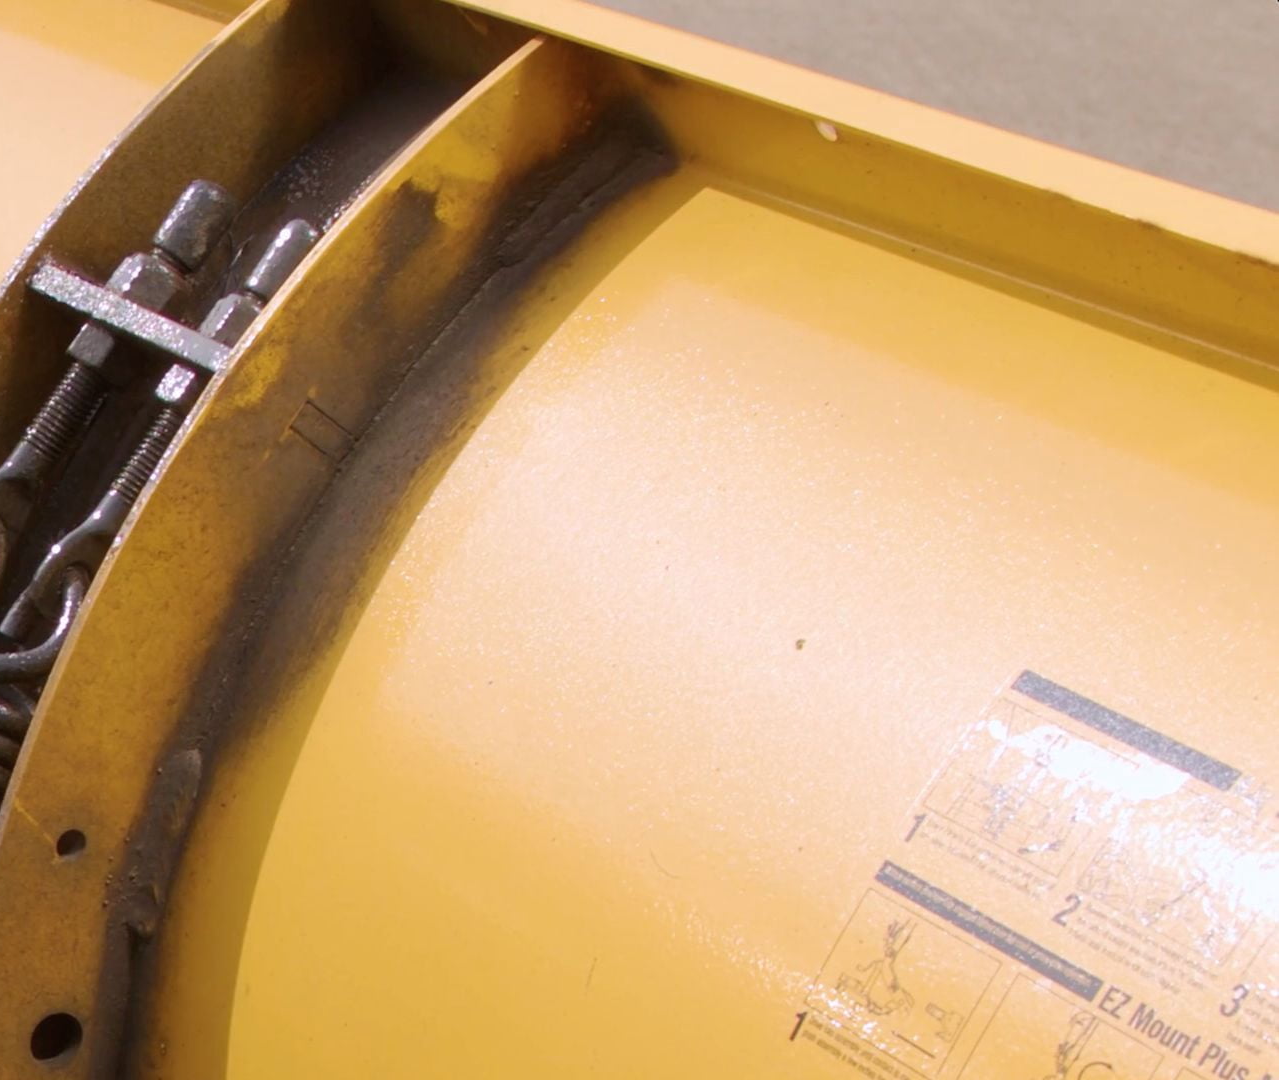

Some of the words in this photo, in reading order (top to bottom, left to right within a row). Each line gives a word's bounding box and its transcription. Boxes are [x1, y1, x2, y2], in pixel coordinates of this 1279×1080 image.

[905, 813, 927, 844] 1
[1051, 893, 1082, 928] 2
[1219, 984, 1248, 1019] 3
[788, 1011, 809, 1042] 1
[1097, 984, 1133, 1021] EZ
[1126, 1001, 1204, 1061] Mount
